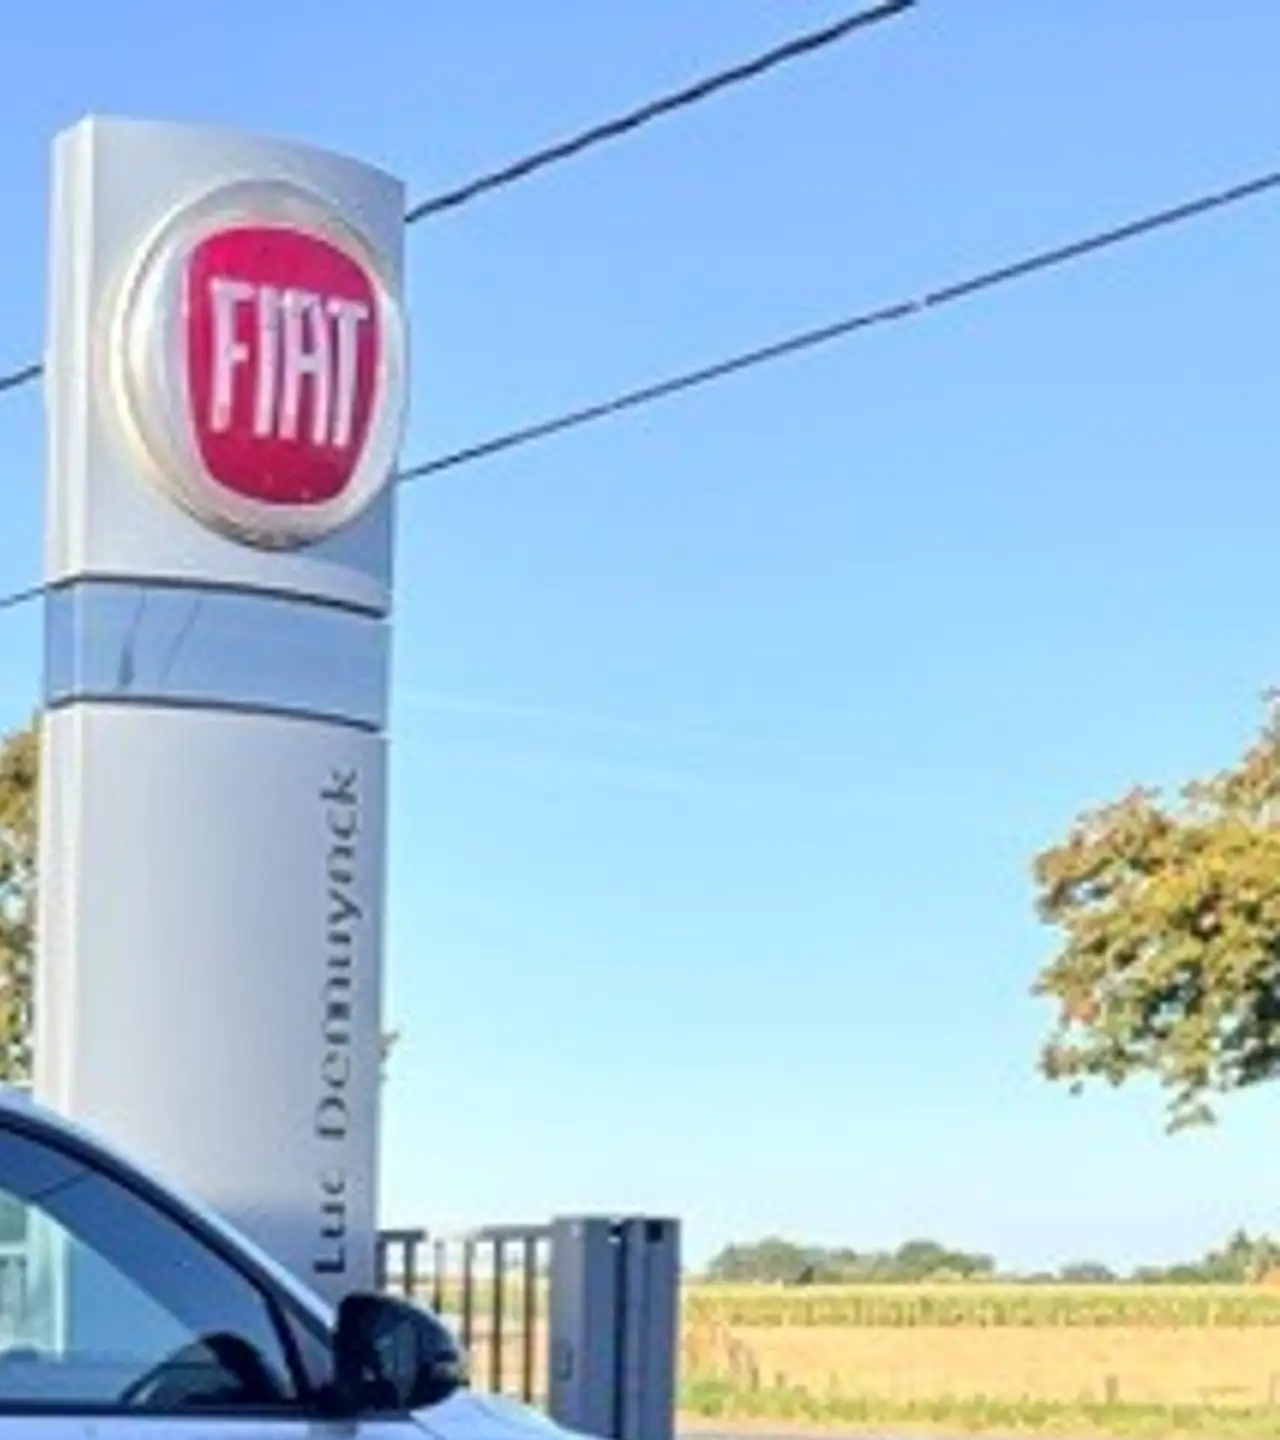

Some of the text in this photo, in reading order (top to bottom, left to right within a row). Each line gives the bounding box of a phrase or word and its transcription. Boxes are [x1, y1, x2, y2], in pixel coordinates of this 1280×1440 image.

[208, 275, 369, 448] FIAT
[312, 767, 363, 1275] Luc Demuynck
